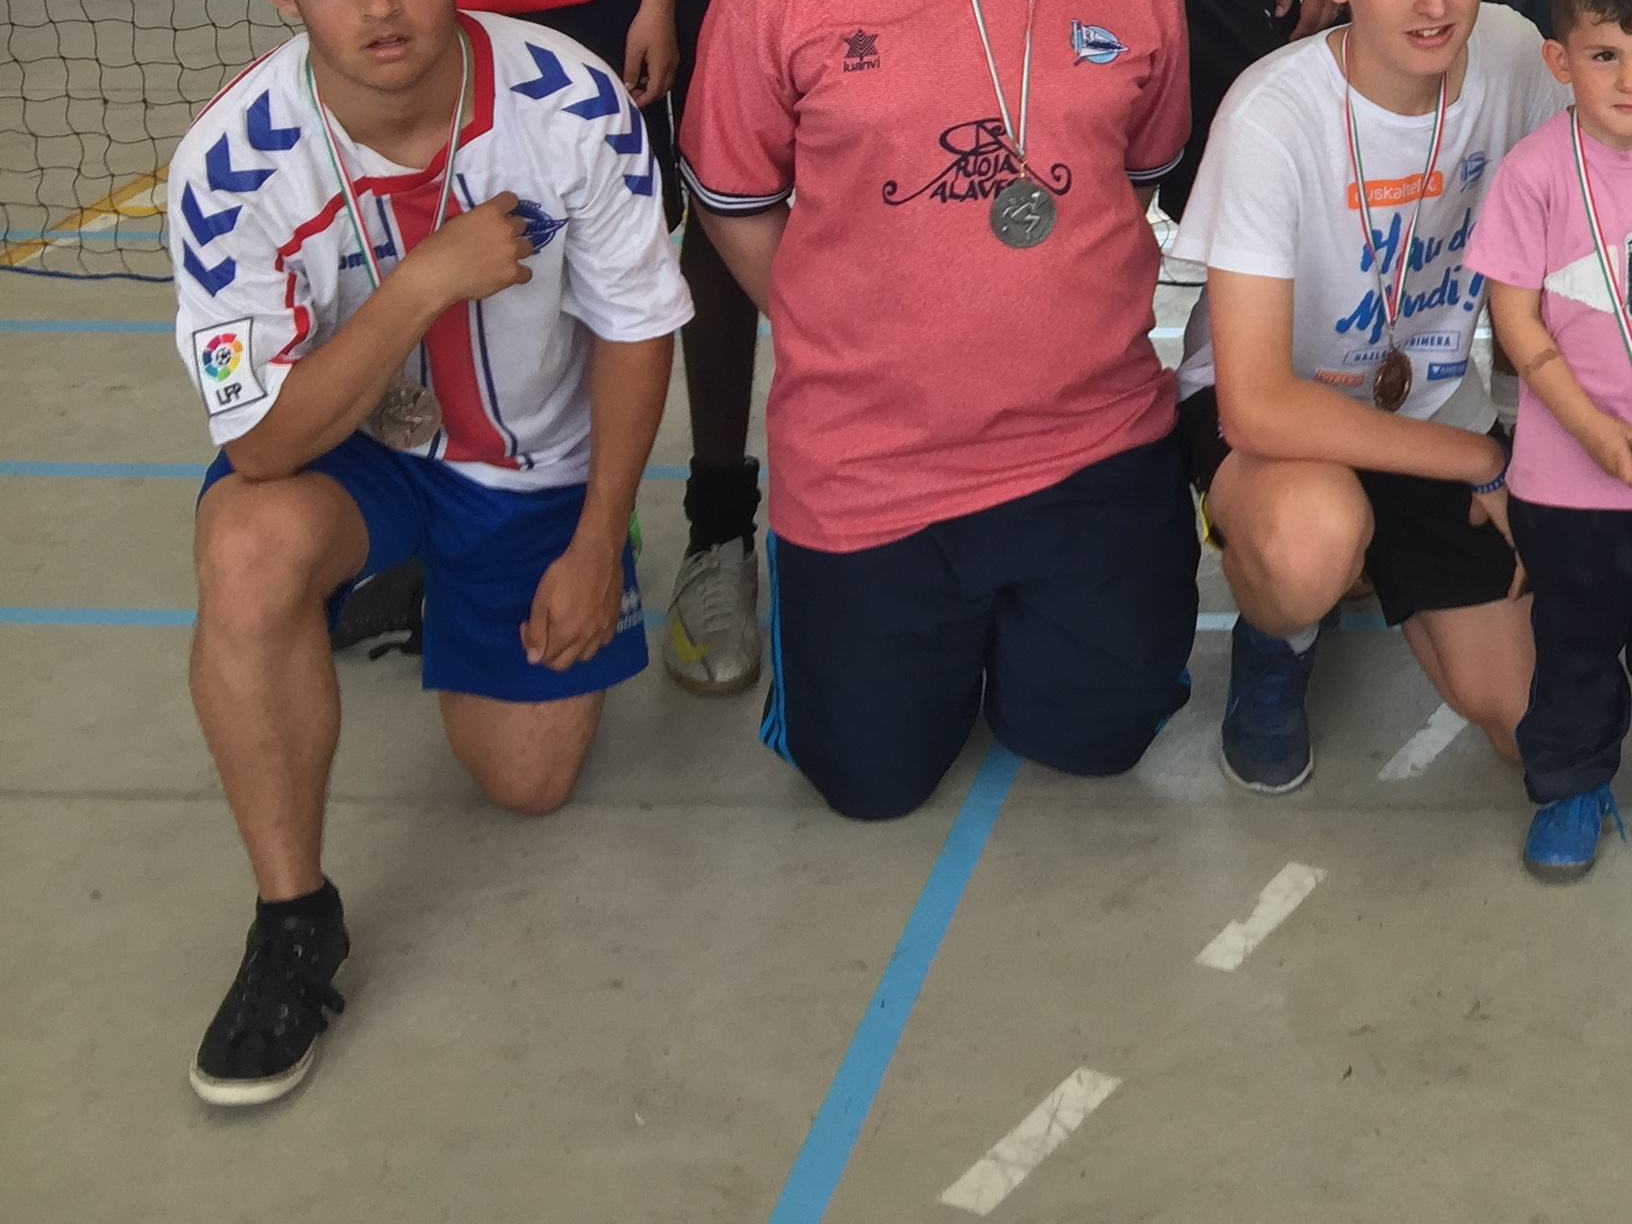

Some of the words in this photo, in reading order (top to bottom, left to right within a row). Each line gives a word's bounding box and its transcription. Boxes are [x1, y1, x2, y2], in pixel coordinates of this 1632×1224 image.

[957, 153, 1020, 178] RIOJA
[930, 176, 1018, 204] ALAVE
[216, 382, 243, 406] LFP
